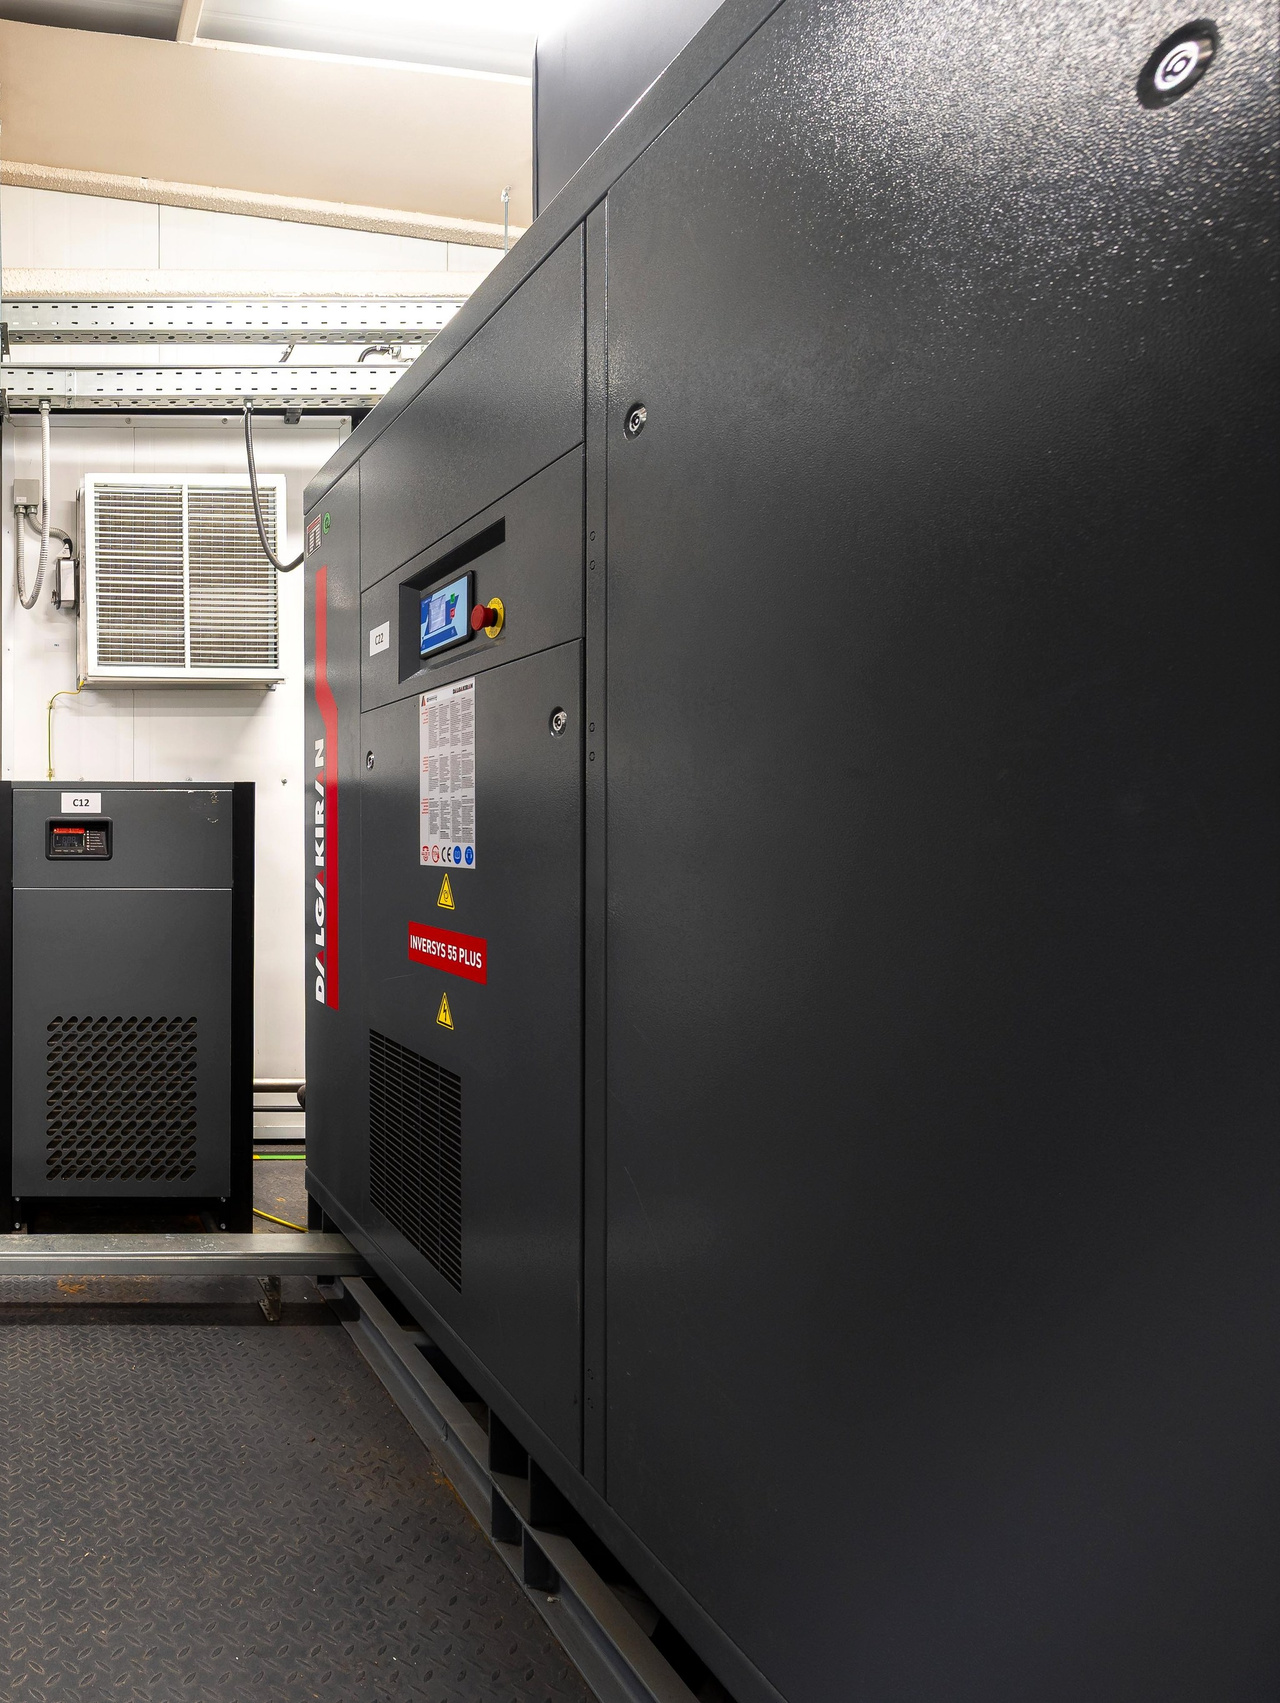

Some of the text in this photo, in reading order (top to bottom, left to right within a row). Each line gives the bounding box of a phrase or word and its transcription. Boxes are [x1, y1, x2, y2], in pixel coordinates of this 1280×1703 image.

[375, 632, 384, 646] C22
[72, 798, 90, 807] C12
[314, 738, 325, 1004] DALGAKIRAN
[410, 934, 482, 969] INVERSYS 55 PLUS
